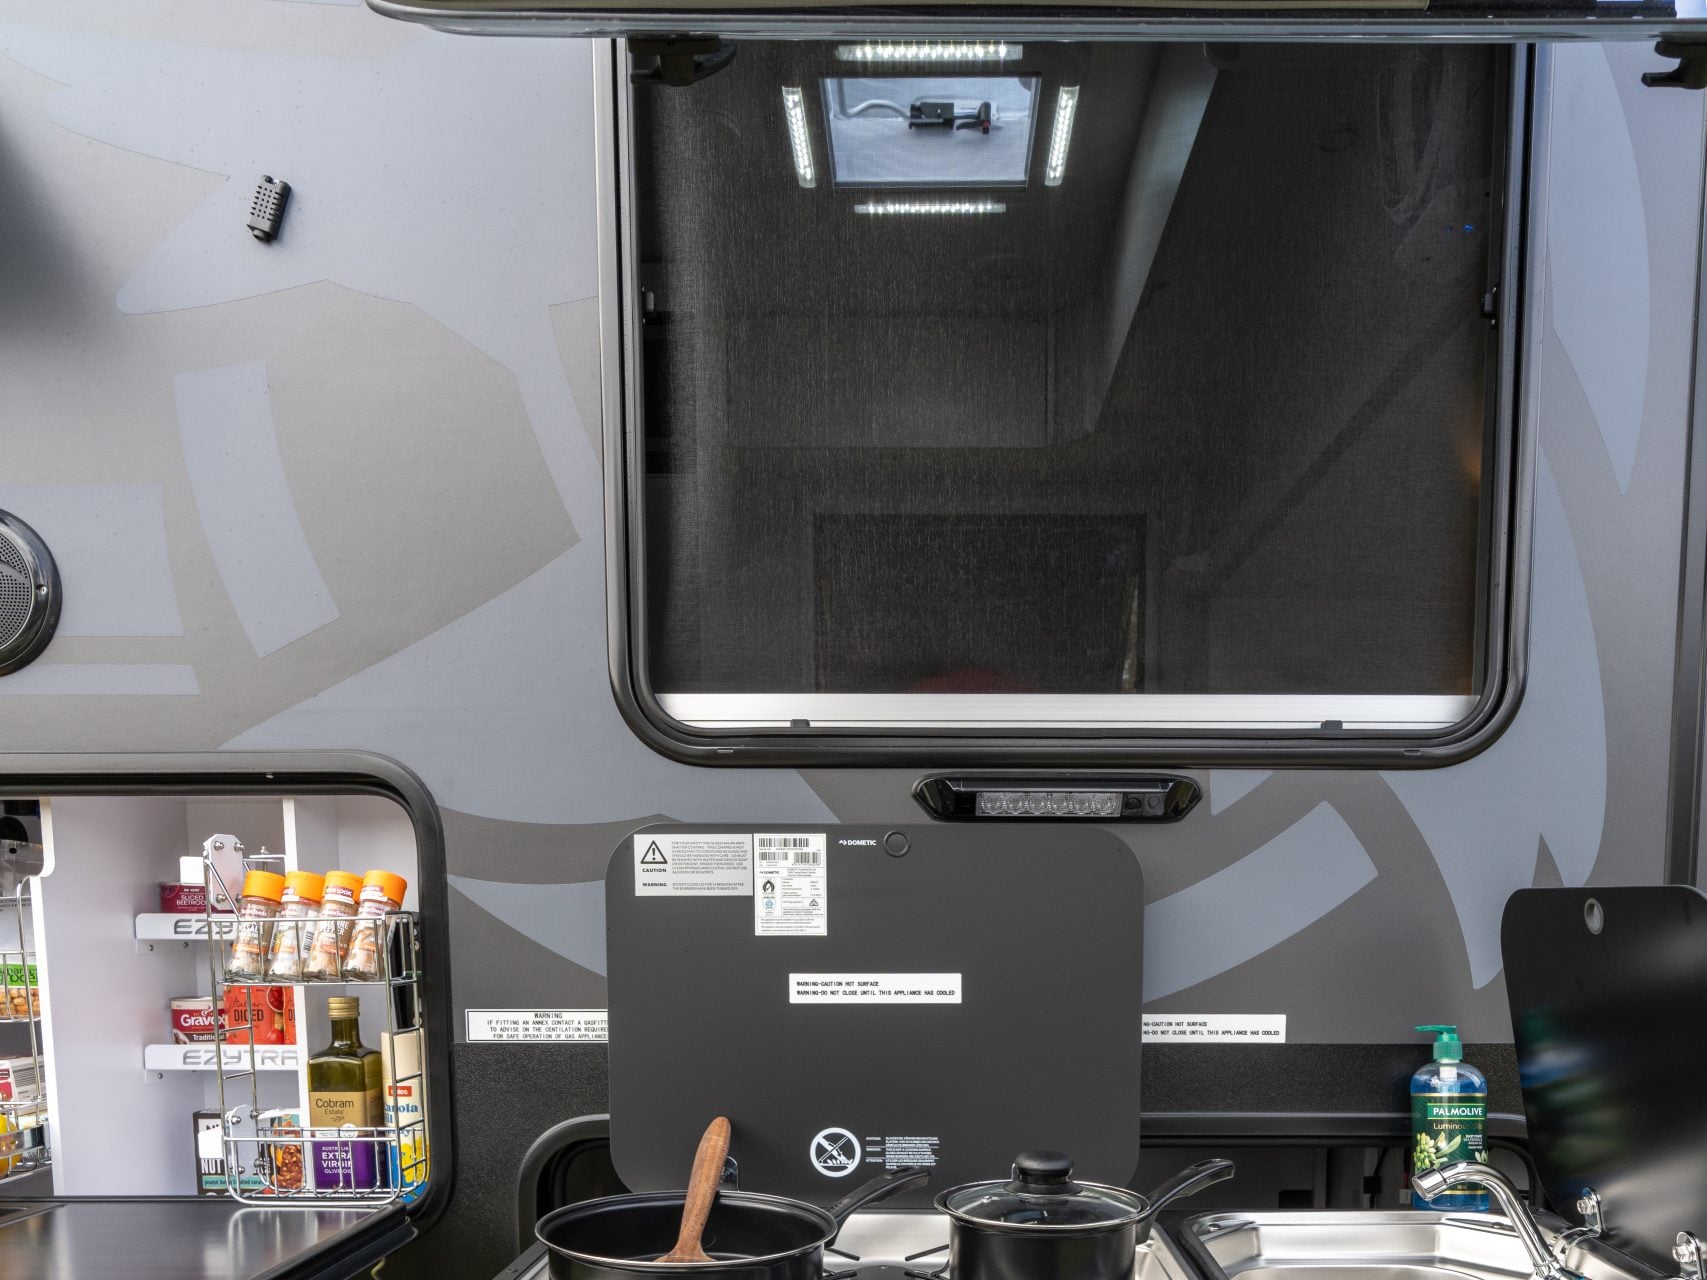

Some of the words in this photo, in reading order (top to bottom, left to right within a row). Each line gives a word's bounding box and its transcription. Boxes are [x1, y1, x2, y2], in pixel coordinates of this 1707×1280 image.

[234, 1009, 264, 1022] DICED
[315, 1098, 354, 1108] Cobram
[1433, 1107, 1483, 1116] PALMOLIVE
[321, 1152, 352, 1160] EXTRA
[201, 1158, 222, 1174] NUT
[321, 1160, 353, 1168] VIRGIN
